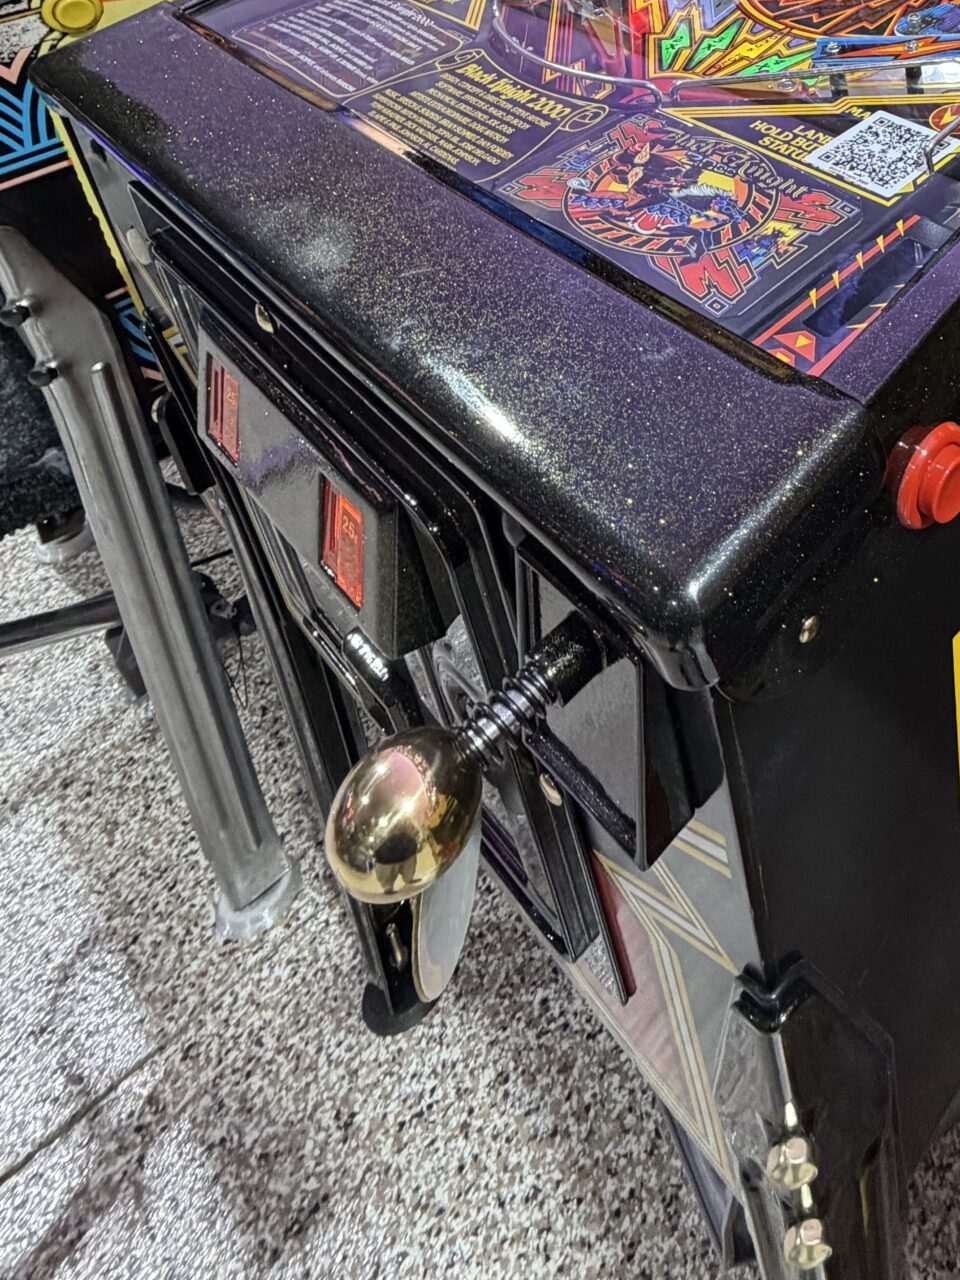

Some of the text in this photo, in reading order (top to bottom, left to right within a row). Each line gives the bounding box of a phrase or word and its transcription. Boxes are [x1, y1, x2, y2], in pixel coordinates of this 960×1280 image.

[456, 63, 498, 85] Black
[487, 78, 539, 104] Knight
[527, 97, 573, 121] 2000
[749, 120, 794, 141] HOLD
[758, 136, 808, 161] STATU
